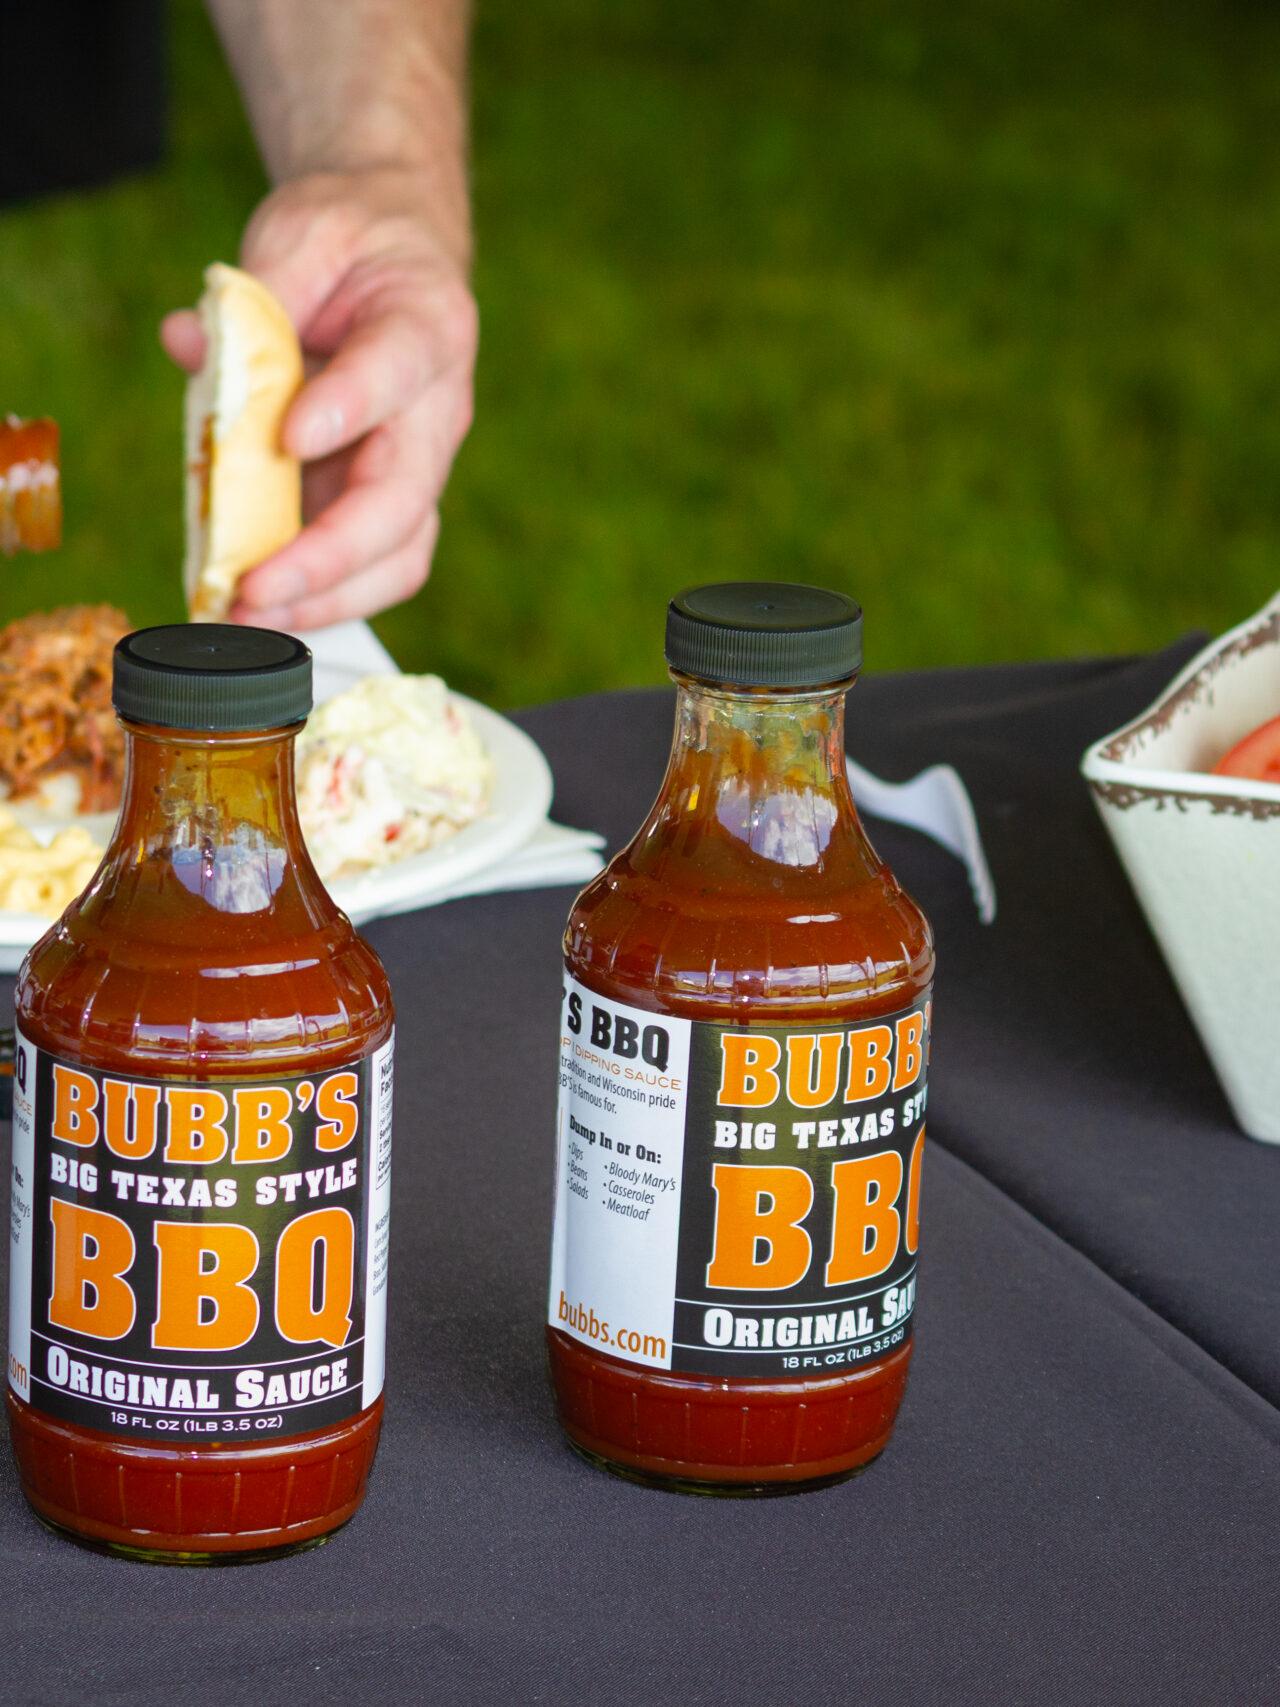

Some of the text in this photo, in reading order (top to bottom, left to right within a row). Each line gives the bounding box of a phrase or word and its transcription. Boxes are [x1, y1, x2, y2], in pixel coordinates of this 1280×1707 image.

[589, 1004, 671, 1073] BBQ
[716, 1000, 932, 1109] BUBB'
[561, 1056, 676, 1110] tradition and Wisconsin pride
[575, 1044, 621, 1075] DIPPING
[623, 1067, 682, 1091] SAUCE
[51, 1062, 359, 1165] BUBB'S
[578, 1084, 603, 1109] famous
[604, 1096, 618, 1115] for.
[569, 1113, 662, 1165] Dump In or On:
[713, 1120, 777, 1150] BIG
[791, 1107, 895, 1151] TEXAS
[570, 1159, 589, 1182] Beans
[571, 1142, 584, 1161] Dips
[50, 1152, 358, 1208] BIG TEXAS STYLE
[569, 1177, 590, 1201] Salads
[608, 1161, 677, 1193] Bloody Mary's
[608, 1179, 656, 1205] Casseroles
[606, 1196, 651, 1222] Meatloaf
[48, 1195, 355, 1352] BBQ
[557, 1290, 667, 1360] bubbs.com
[782, 1356, 800, 1369] 18
[803, 1355, 822, 1368] FL
[824, 1352, 846, 1365] OZ
[847, 1345, 872, 1362] (1LB
[873, 1338, 890, 1352] 3.5
[110, 1411, 283, 1434] 18 FL OZ (1LB 3.5 OZ)
